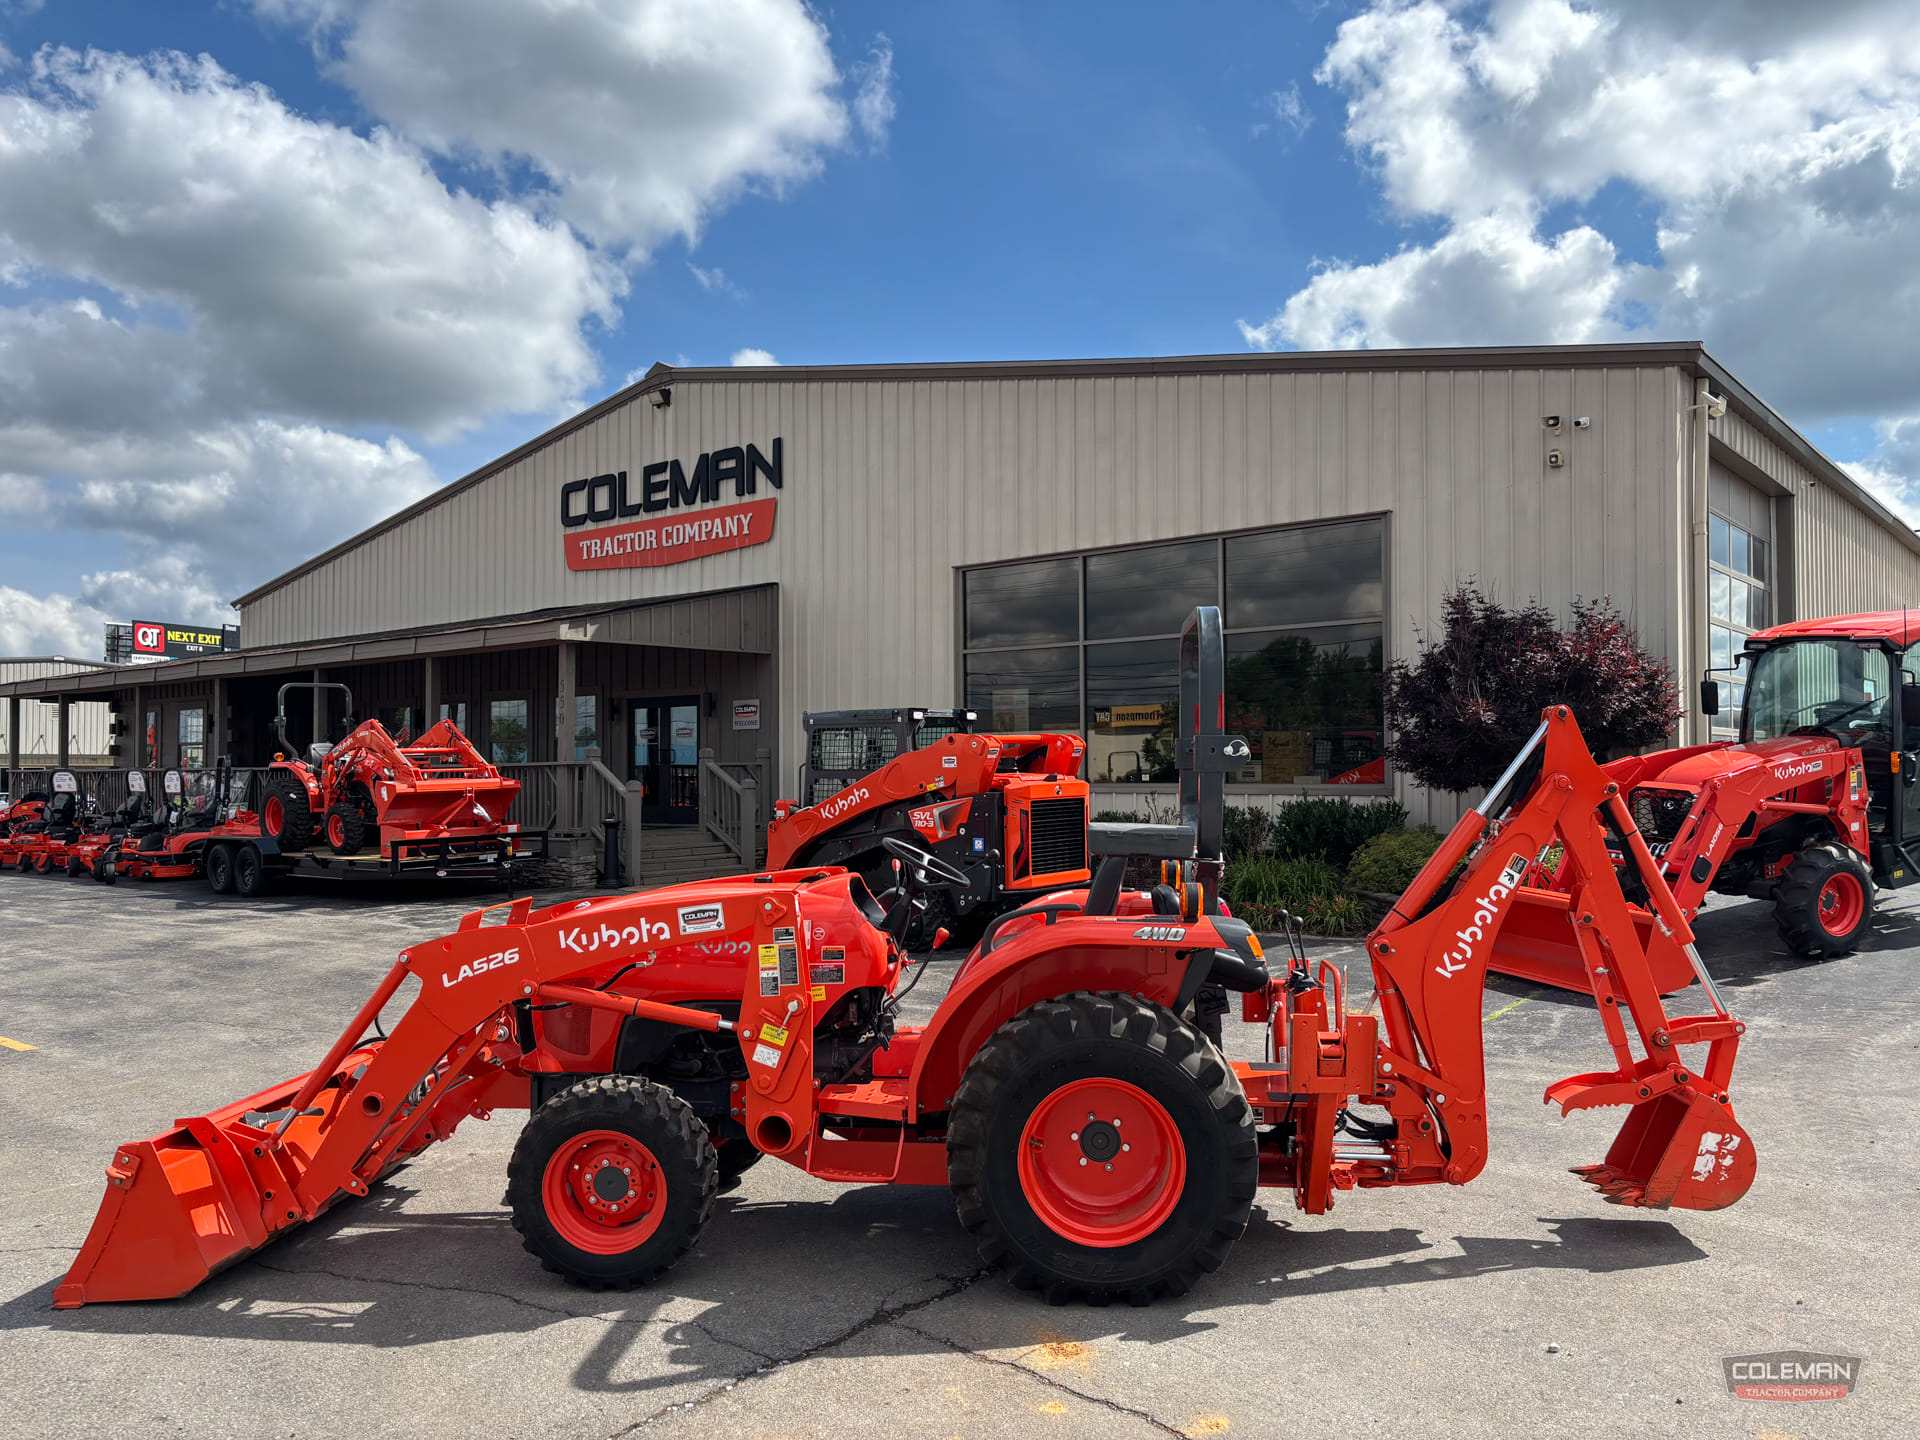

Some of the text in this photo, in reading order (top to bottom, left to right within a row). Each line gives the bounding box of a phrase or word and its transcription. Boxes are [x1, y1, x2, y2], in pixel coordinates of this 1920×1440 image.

[561, 437, 783, 528] COLEMAN
[580, 513, 753, 560] TRACTOR COMPANY
[137, 627, 161, 648] QT
[167, 630, 222, 645] NEXT EXIT
[1774, 762, 1812, 780] Kubota
[820, 786, 870, 819] Kubota
[912, 811, 934, 821] SVL
[914, 820, 934, 828] 110-3
[1705, 822, 1723, 857] LA1056
[684, 910, 717, 920] COLEMAN
[558, 917, 671, 954] Kubota
[1133, 926, 1186, 942] 4WD
[1435, 884, 1510, 979] Kubota
[442, 948, 520, 988] LA526
